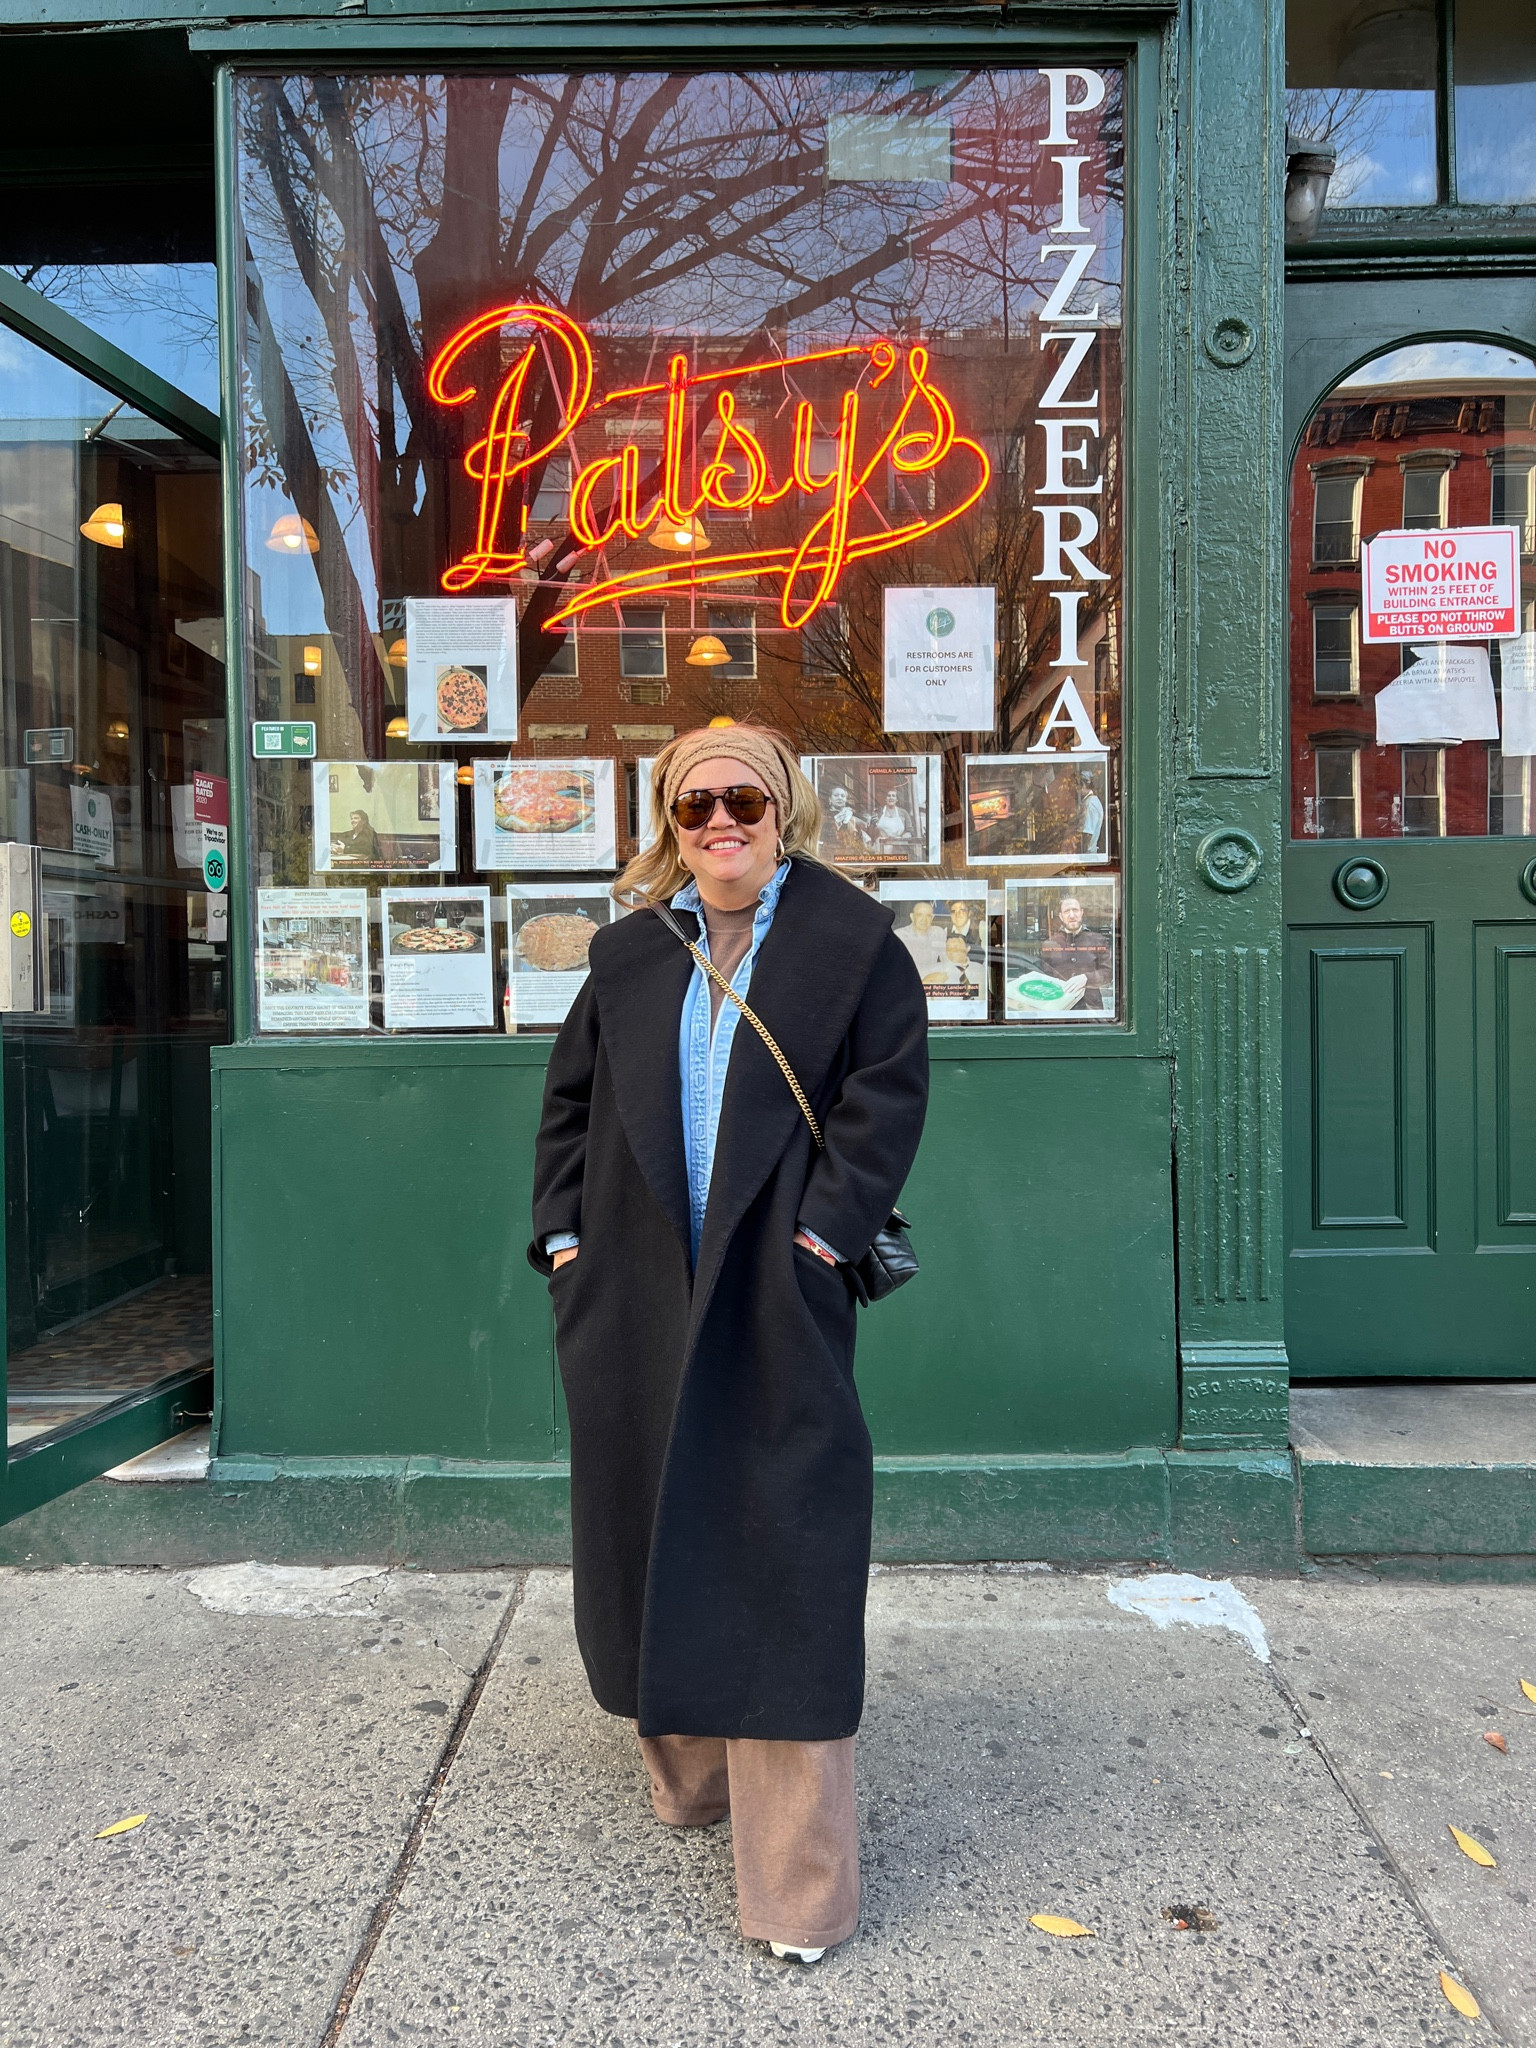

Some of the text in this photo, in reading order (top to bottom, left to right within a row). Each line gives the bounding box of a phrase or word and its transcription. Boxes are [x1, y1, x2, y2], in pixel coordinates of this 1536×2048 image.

[1027, 68, 1111, 752] PIZZERIA
[428, 303, 990, 630] Patsy's
[1424, 540, 1456, 559] NO
[1385, 561, 1497, 584] SMOKING
[1388, 584, 1494, 597] WITHIN 25 FEET OF
[1384, 596, 1499, 609] BUILDING ENTRANCE
[1377, 610, 1506, 625] PLEASE DO NOT THROW
[1389, 622, 1494, 636] BUTTS ON GROUND
[196, 779, 214, 790] ZAGAT
[196, 788, 214, 798] RATED
[206, 828, 217, 836] We're
[204, 834, 226, 844] Tripadvisor
